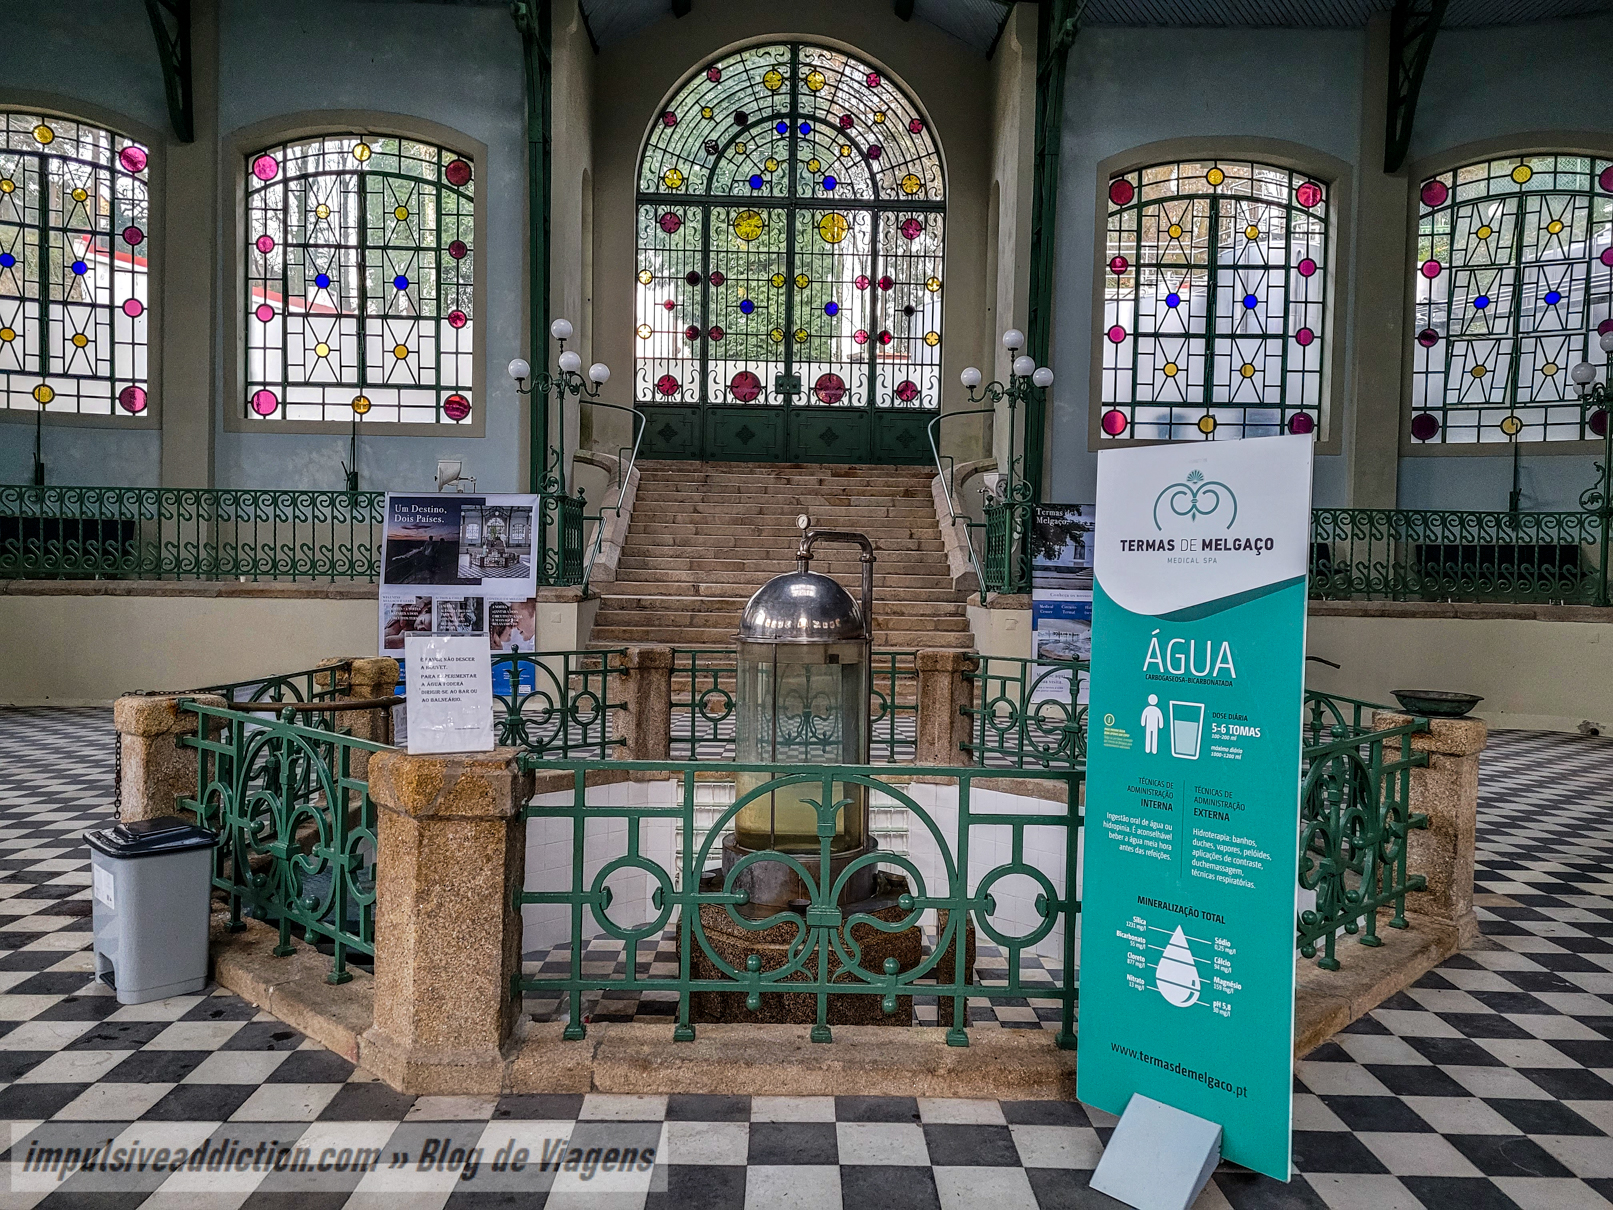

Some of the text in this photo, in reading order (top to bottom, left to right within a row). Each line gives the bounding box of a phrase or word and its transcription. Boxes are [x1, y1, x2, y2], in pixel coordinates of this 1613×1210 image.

[395, 504, 448, 514] Um Destino,
[1036, 507, 1063, 516] Termas
[394, 514, 445, 523] Dois Países.
[1120, 537, 1274, 556] TERMAS DE MELGAÇO
[1143, 628, 1236, 679] ÁGUA
[1145, 673, 1234, 687] CARBOGASEOSA-BICARBONATADA
[1212, 712, 1249, 722] DOSE DIÁRIA
[1211, 722, 1261, 738] 5-6 TOMAS
[1138, 776, 1174, 790] TÉCNICAS DE
[1127, 785, 1174, 800] ADMINISTRAÇÃO
[1194, 785, 1233, 799] TÉCNICAS DE
[1141, 798, 1173, 812] INTERNA
[1194, 796, 1246, 811] ADMINISTRAÇÃO
[1106, 811, 1129, 823] Ingestão
[1130, 817, 1140, 825] oral
[1141, 818, 1149, 826] de
[1149, 819, 1164, 830] água
[1193, 807, 1230, 822] EXTERNA
[1102, 820, 1173, 841] hidropinia. É aconselhável
[1192, 828, 1258, 848] Hidroterapia: banhos,
[1108, 831, 1124, 841] beber
[1129, 835, 1143, 845] água
[1143, 838, 1158, 848] meia
[1158, 841, 1172, 851] hora
[1119, 844, 1172, 861] antes das refeições.
[1192, 838, 1272, 861] duches, vapores, pelóides,
[1191, 849, 1264, 870] aplicações de contraste,
[1191, 858, 1244, 877] duchemassagem,
[1191, 868, 1256, 889] técnicas respiratórias.
[1137, 895, 1226, 925] MINERALIZAÇÃO TOTAL
[1116, 929, 1146, 944] Bicarbonato
[1214, 937, 1231, 948] Sódio
[1127, 951, 1146, 963] Cloreto
[1213, 956, 1231, 967] Cálcio
[1126, 973, 1145, 985] Nitrato
[1213, 976, 1242, 991] Magnésio
[1212, 1000, 1221, 1009] pH
[1111, 1041, 1248, 1099] www.termasdemelgaco.pt
